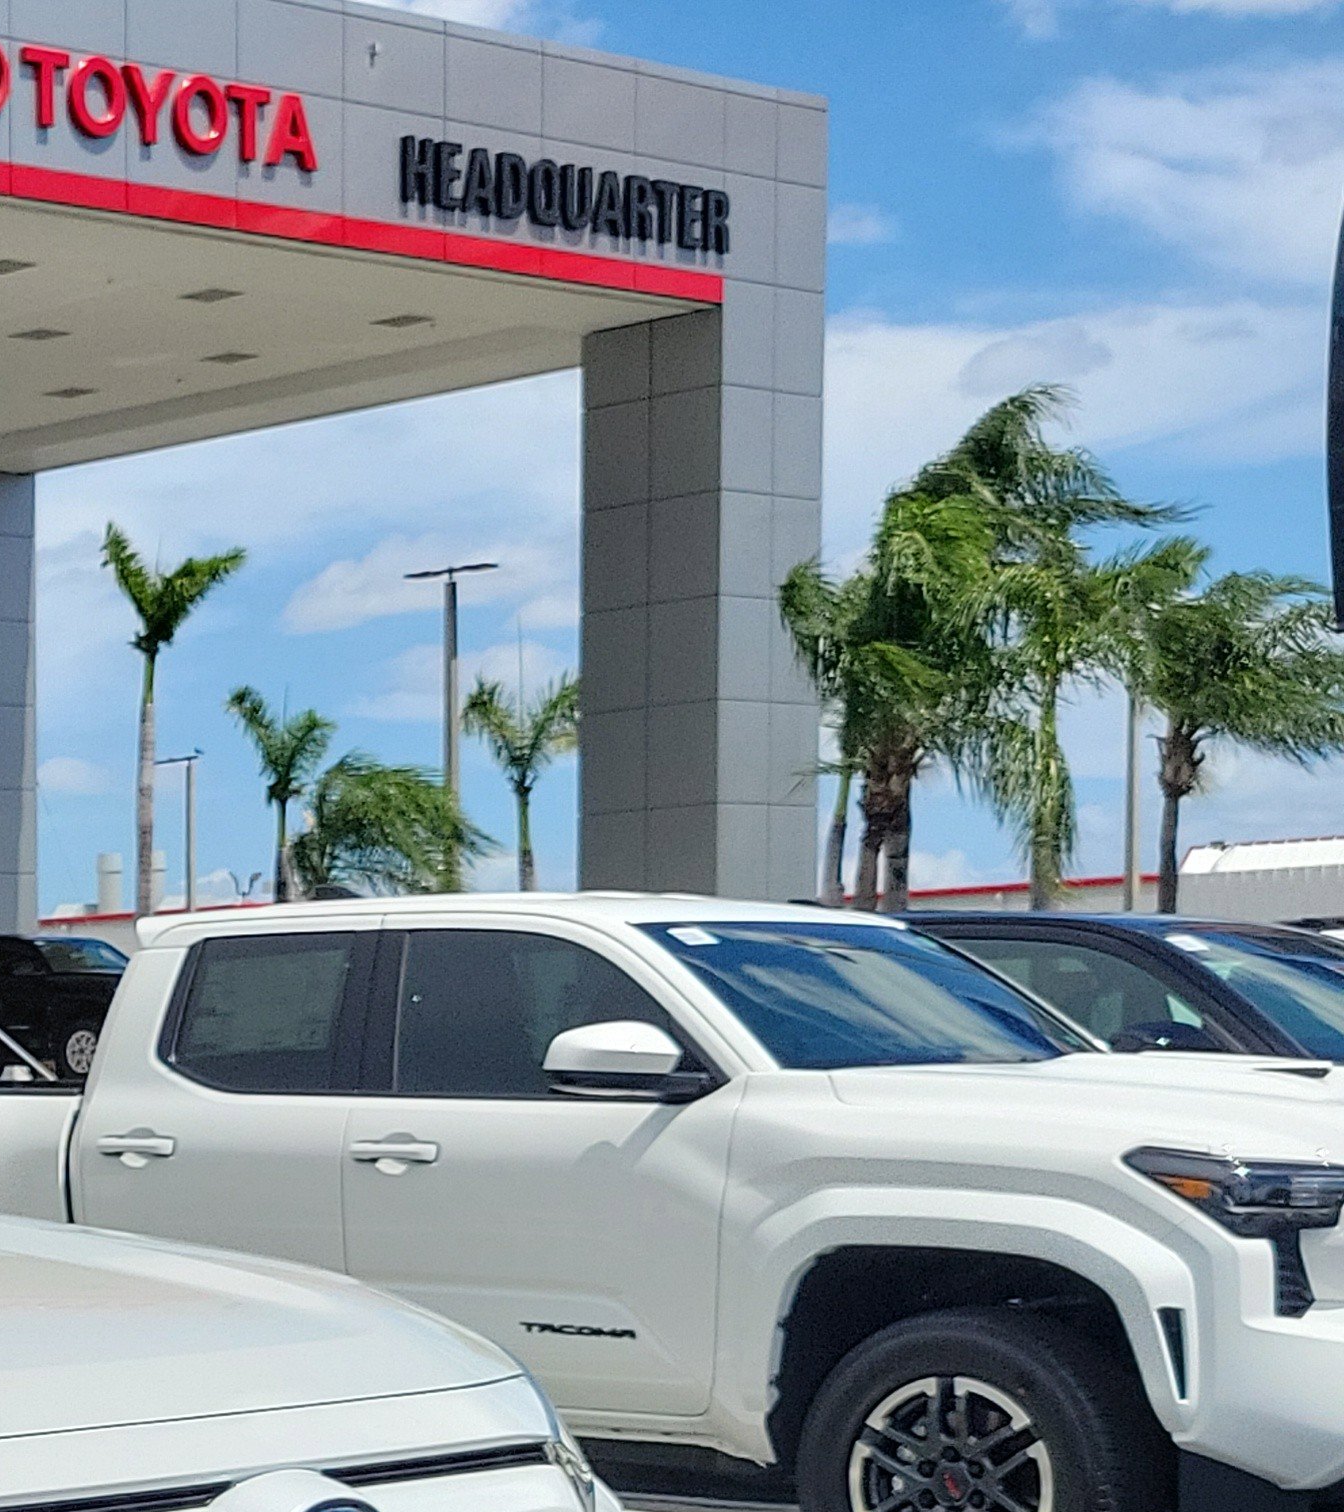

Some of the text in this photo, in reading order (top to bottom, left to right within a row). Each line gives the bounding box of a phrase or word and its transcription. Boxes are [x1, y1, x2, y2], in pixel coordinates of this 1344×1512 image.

[19, 45, 731, 253] TOYOTA HEADQUARTER
[519, 1321, 637, 1340] TACOMA
